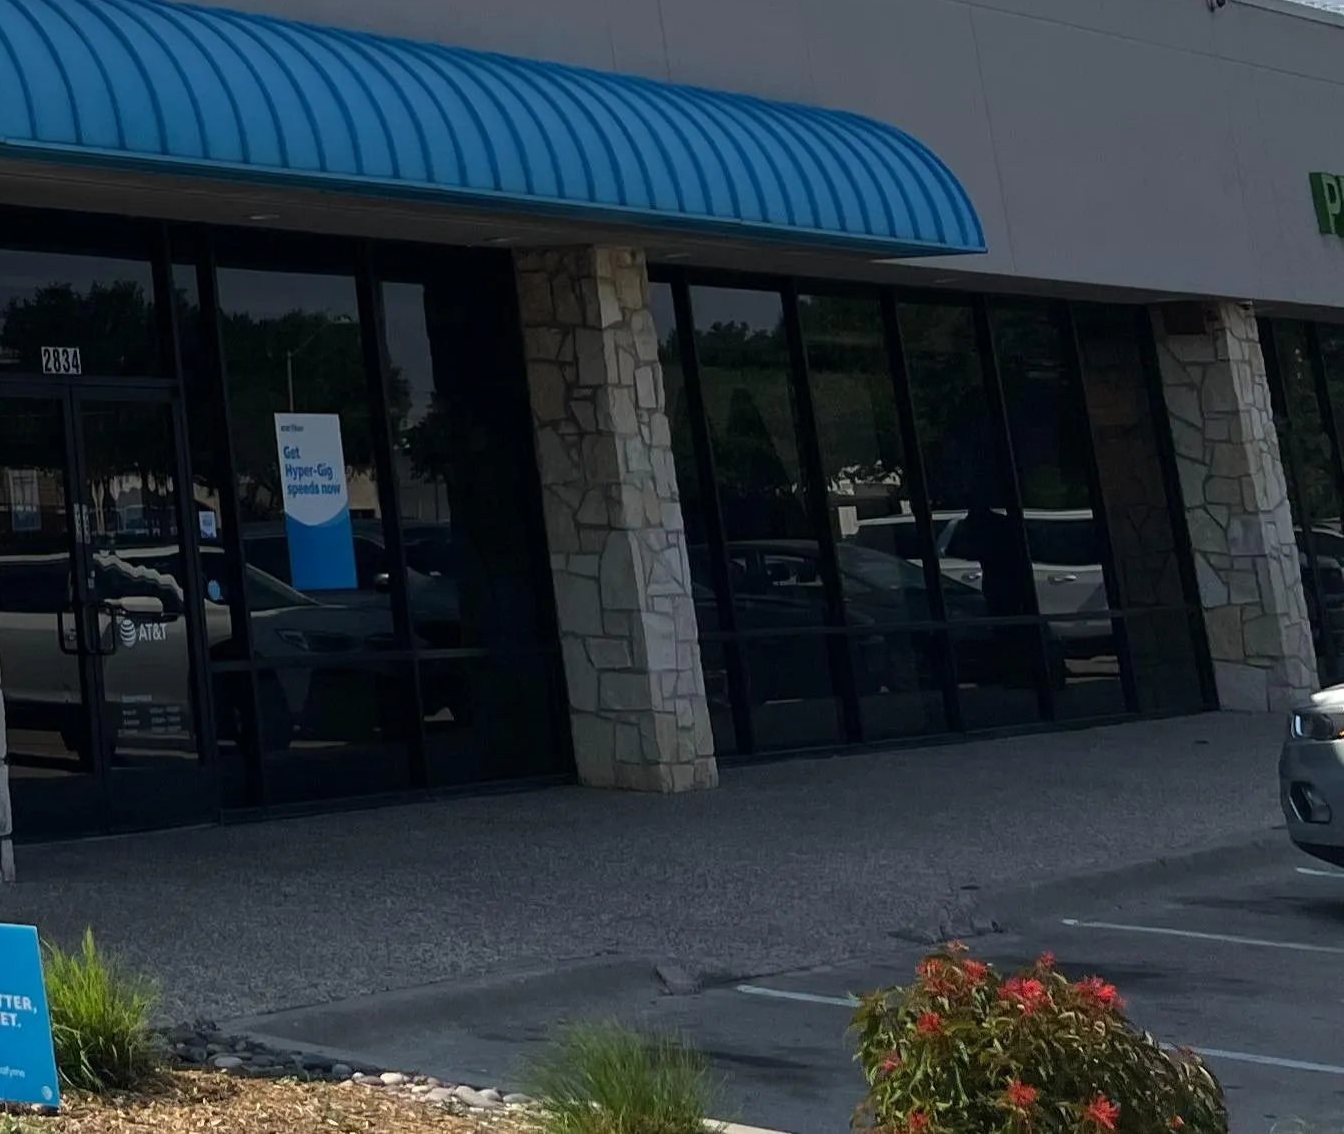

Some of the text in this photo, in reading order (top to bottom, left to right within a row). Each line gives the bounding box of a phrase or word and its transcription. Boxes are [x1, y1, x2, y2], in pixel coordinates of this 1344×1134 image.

[1309, 172, 1344, 239] P
[42, 348, 81, 374] 2834
[283, 446, 301, 460] Get
[285, 463, 334, 482] Hyper-Gig
[287, 481, 341, 499] speeds now
[139, 621, 167, 641] AT&T
